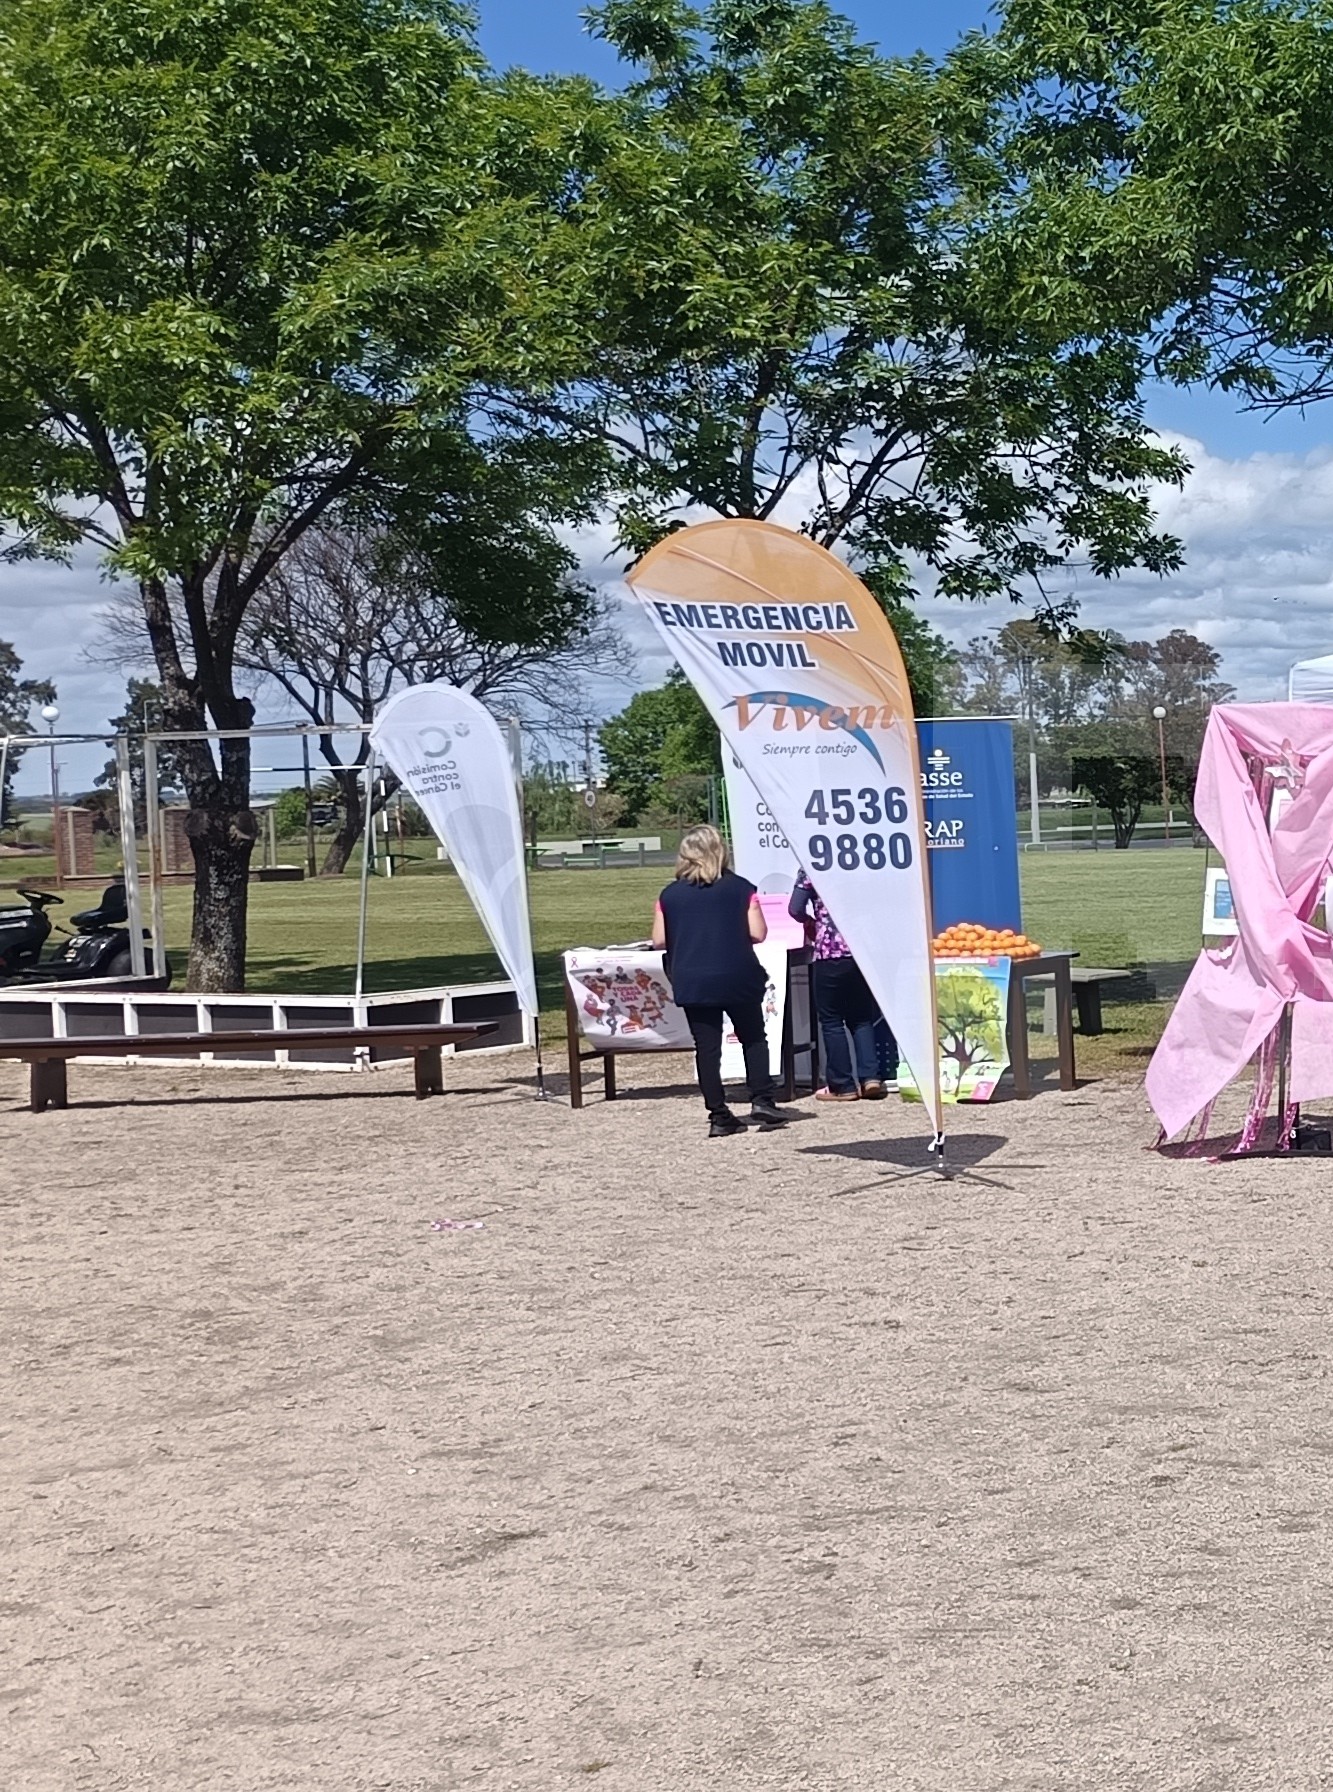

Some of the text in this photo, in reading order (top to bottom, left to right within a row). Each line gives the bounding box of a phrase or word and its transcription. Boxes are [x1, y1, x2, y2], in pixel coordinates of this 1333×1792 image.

[653, 602, 855, 631] EMERGENCIA
[717, 642, 816, 668] MOVIL
[731, 694, 897, 732] Vivem
[762, 743, 858, 757] Siempre contigo
[920, 771, 963, 787] asse
[804, 787, 908, 826] 4536
[808, 832, 913, 872] 9880
[927, 837, 965, 846] oriano
